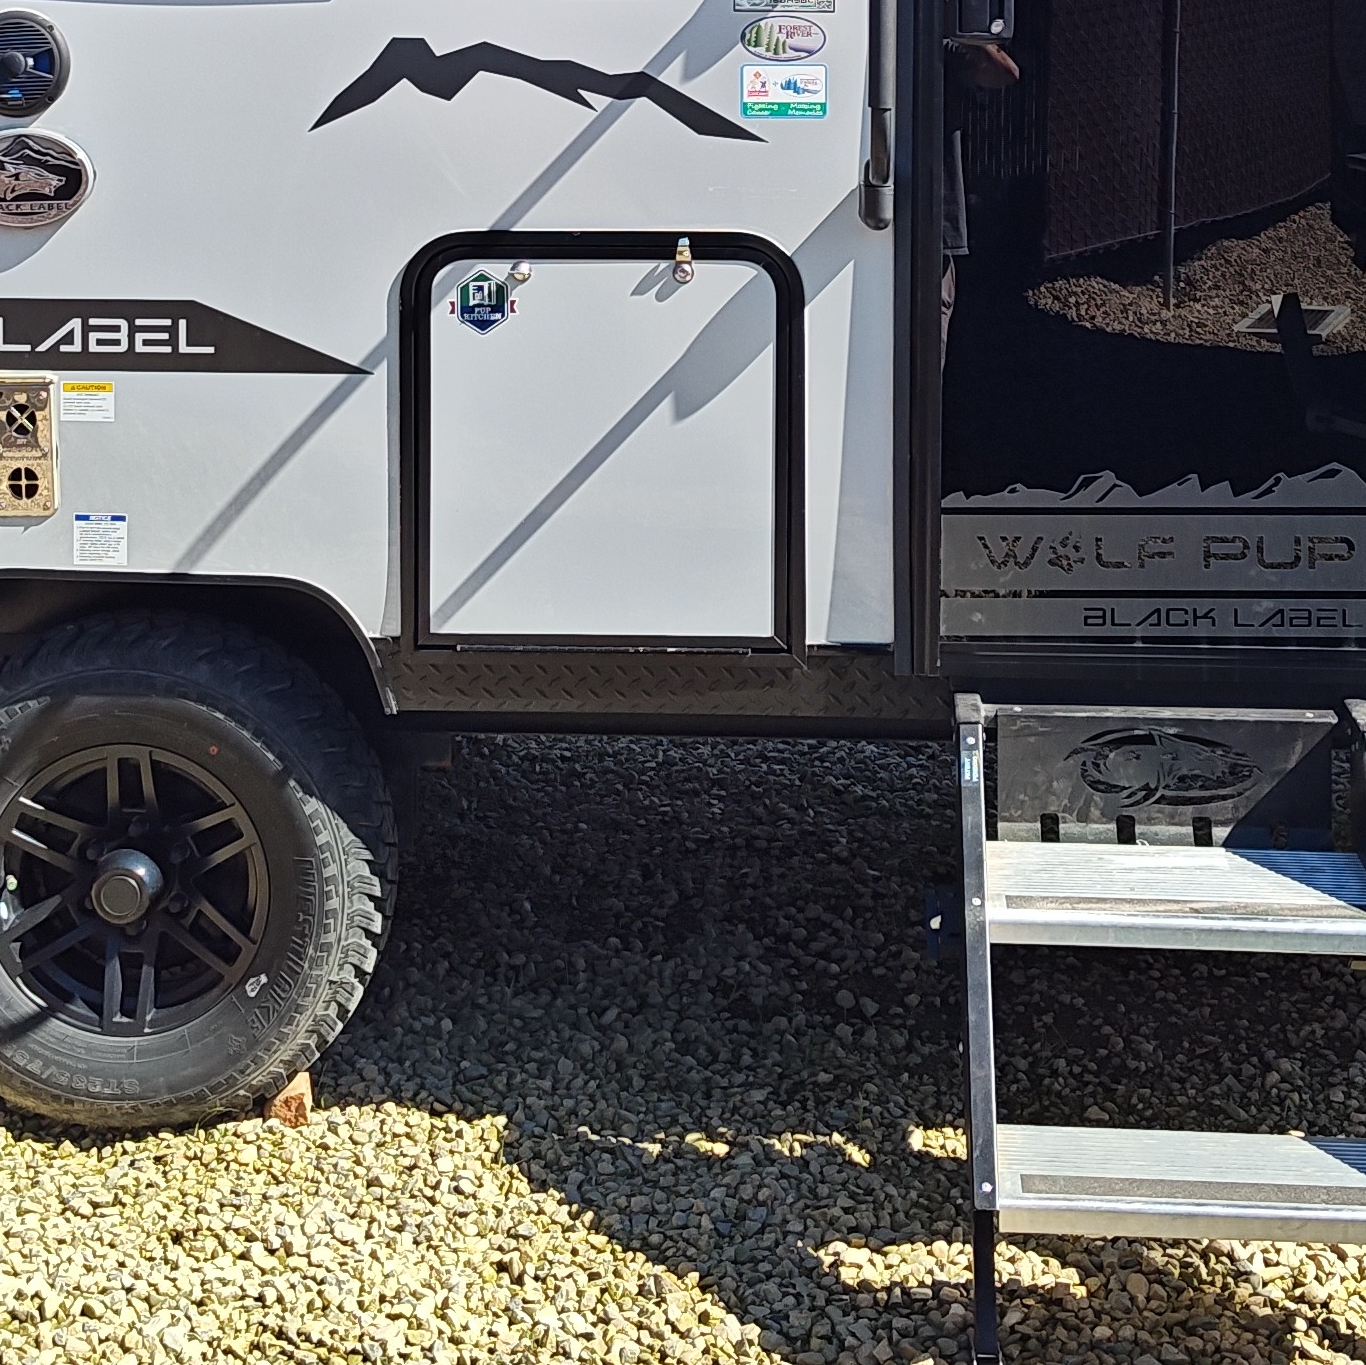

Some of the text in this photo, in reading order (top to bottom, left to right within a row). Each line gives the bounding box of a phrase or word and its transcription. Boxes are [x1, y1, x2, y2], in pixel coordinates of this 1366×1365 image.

[777, 24, 813, 35] FOREST
[785, 30, 813, 40] RIVER
[30, 203, 72, 212] LABEL
[1202, 535, 1356, 570] PUP
[1082, 607, 1364, 629] BLACK LABEL
